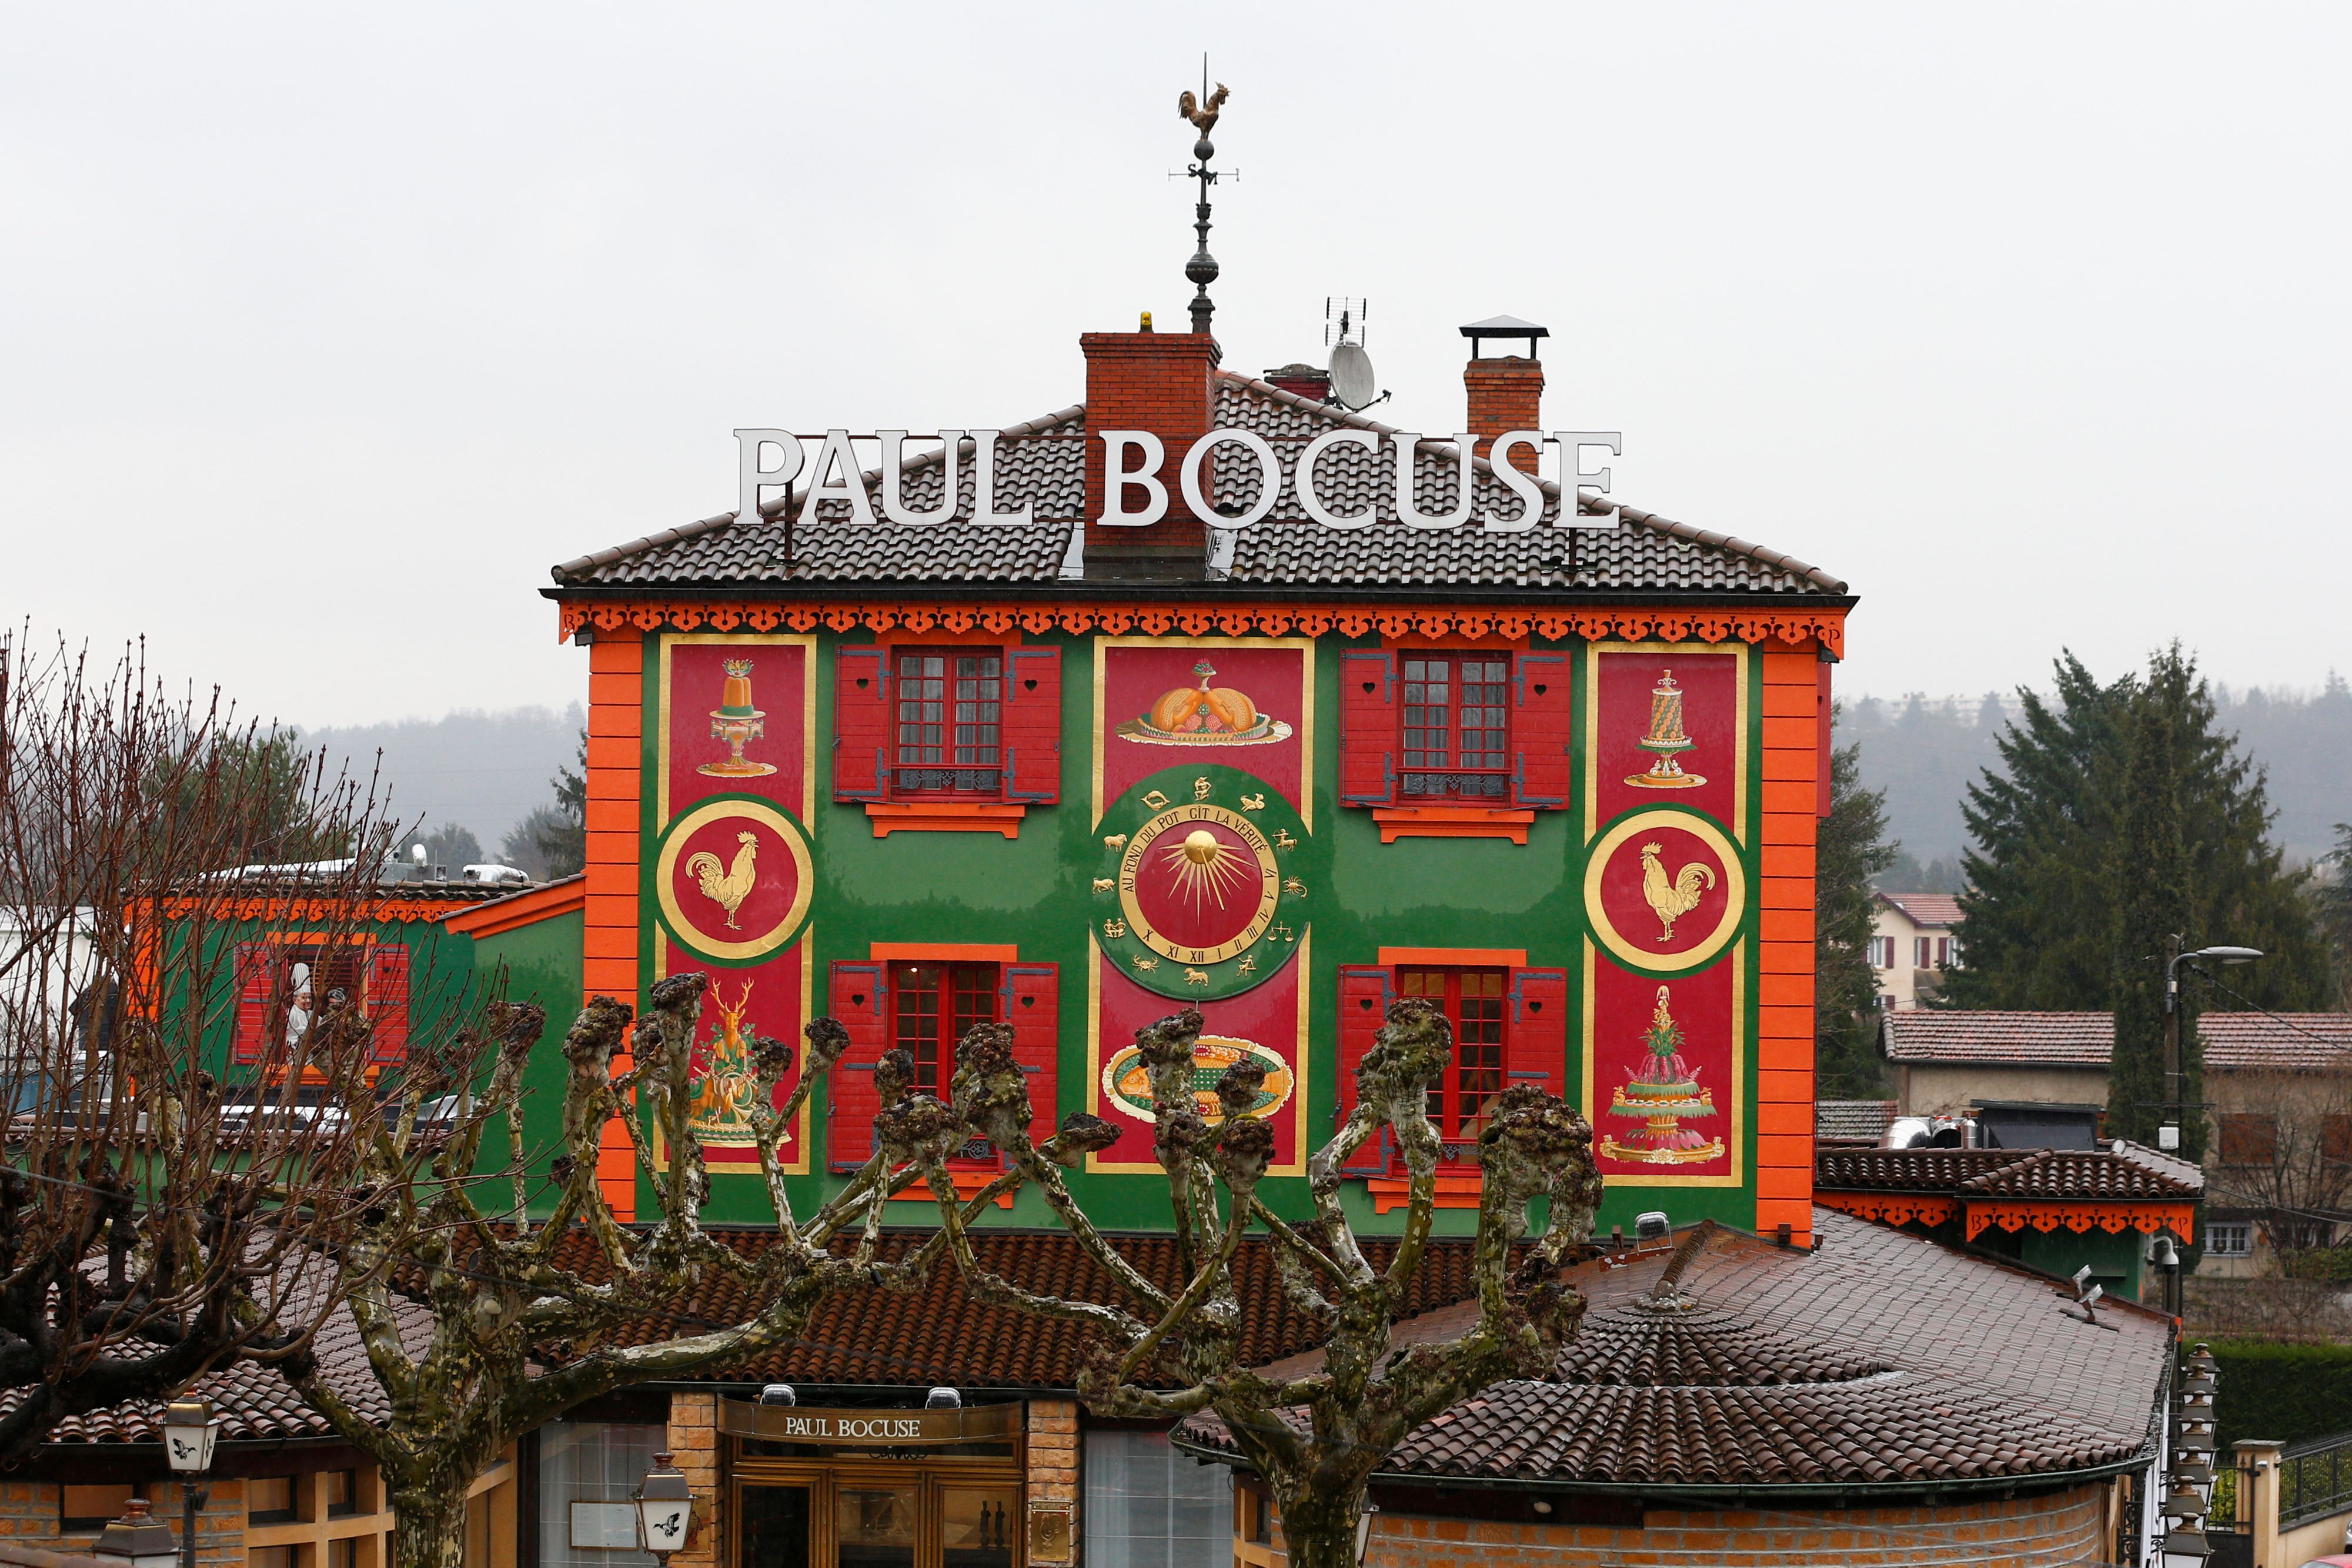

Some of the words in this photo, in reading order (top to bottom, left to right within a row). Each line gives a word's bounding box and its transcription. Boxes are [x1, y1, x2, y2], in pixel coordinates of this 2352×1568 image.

[1188, 163, 1197, 178] S
[733, 428, 1034, 526] PAUL
[1096, 427, 1621, 533] BOCUSE
[564, 614, 575, 633] B
[1828, 628, 1840, 647] P
[1190, 805, 1210, 820] GÎT
[1215, 810, 1230, 825] LA
[1157, 811, 1179, 830] POT
[1140, 826, 1156, 844] DU
[1235, 819, 1268, 854] VÉRITÉ
[1124, 844, 1143, 873] FOND
[1264, 868, 1277, 878] VI
[1122, 877, 1134, 892] AU
[1264, 891, 1275, 900] V
[1258, 908, 1269, 922] IV
[1142, 929, 1154, 942] X
[1246, 925, 1259, 940] III
[1167, 945, 1180, 958] XI
[1234, 939, 1243, 951] II
[1190, 951, 1204, 962] XII
[1217, 948, 1222, 959] I
[1971, 1214, 1982, 1231] B
[2178, 1216, 2188, 1233] P
[786, 1417, 832, 1436] PAUL
[838, 1419, 920, 1437] BOCUSE
